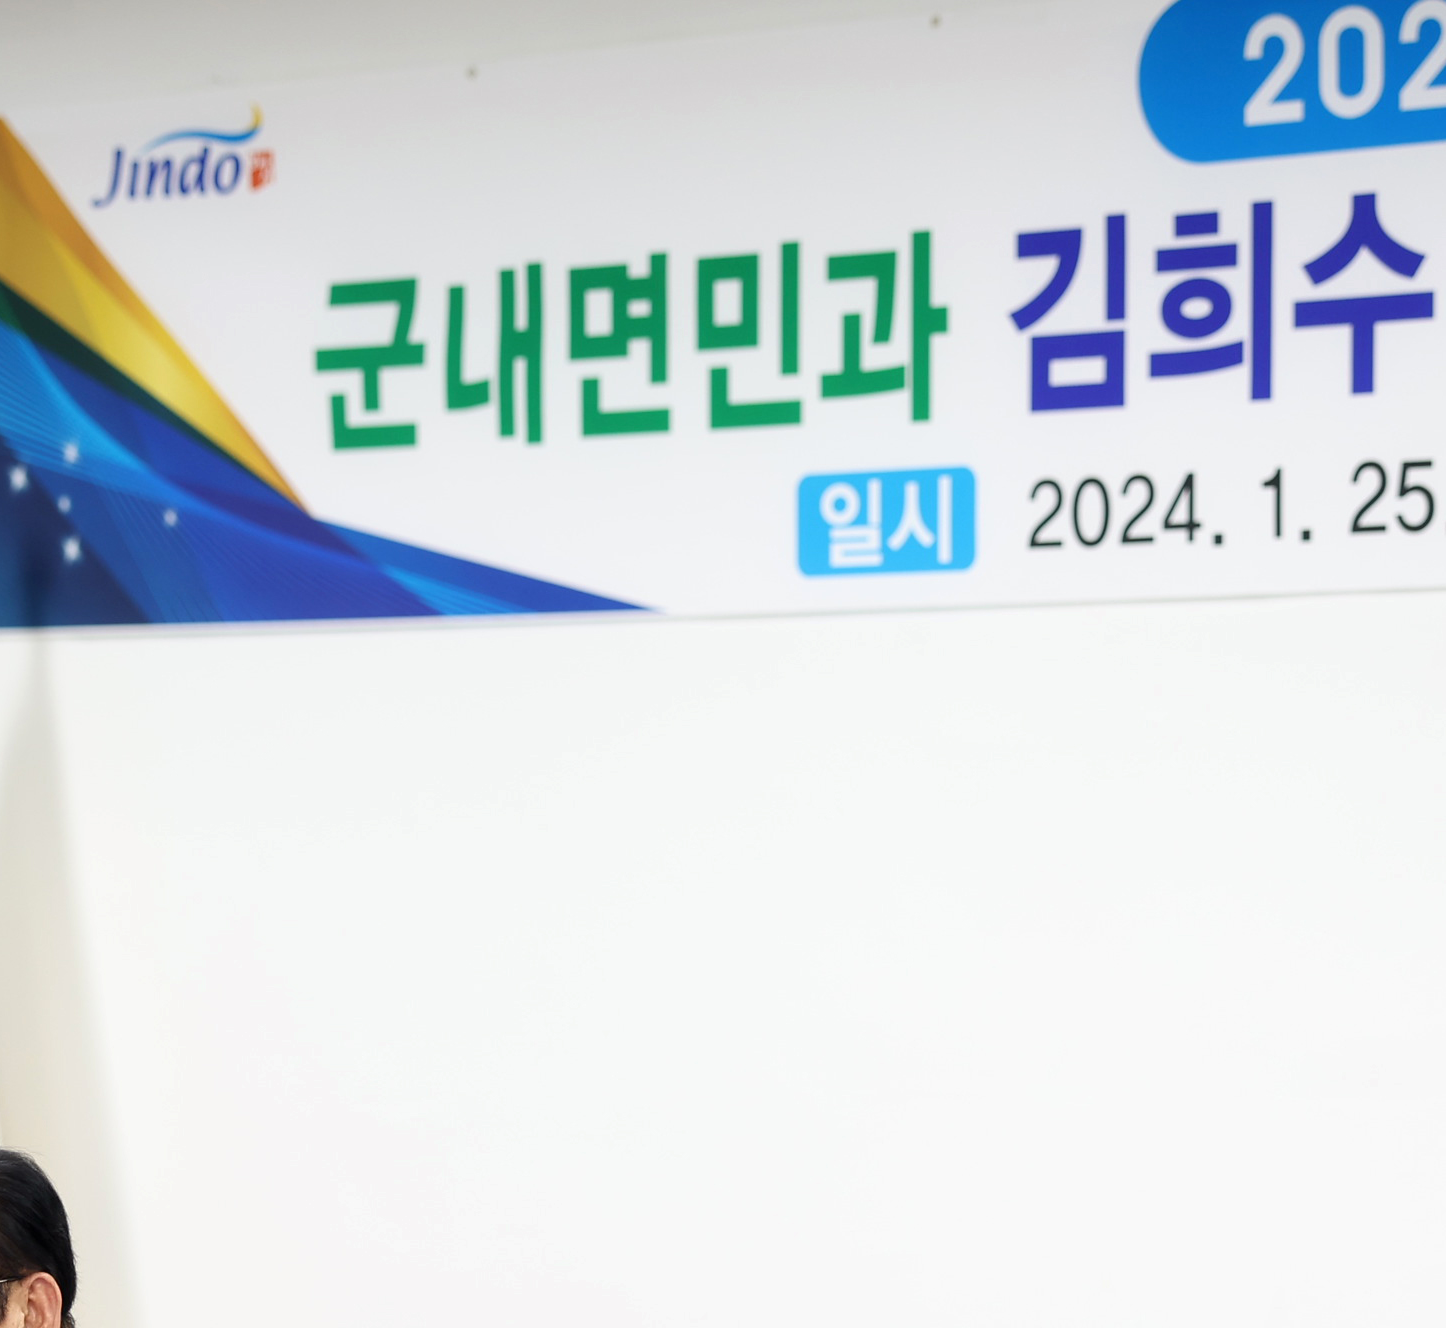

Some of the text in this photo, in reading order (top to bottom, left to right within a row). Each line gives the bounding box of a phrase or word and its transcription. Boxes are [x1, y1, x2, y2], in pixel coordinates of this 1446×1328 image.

[92, 146, 242, 208] Jindo
[315, 193, 1434, 450] 군내면민과 김희수
[818, 474, 953, 567] 일시
[1029, 472, 1224, 548] 2024.
[1262, 467, 1312, 543] 1.
